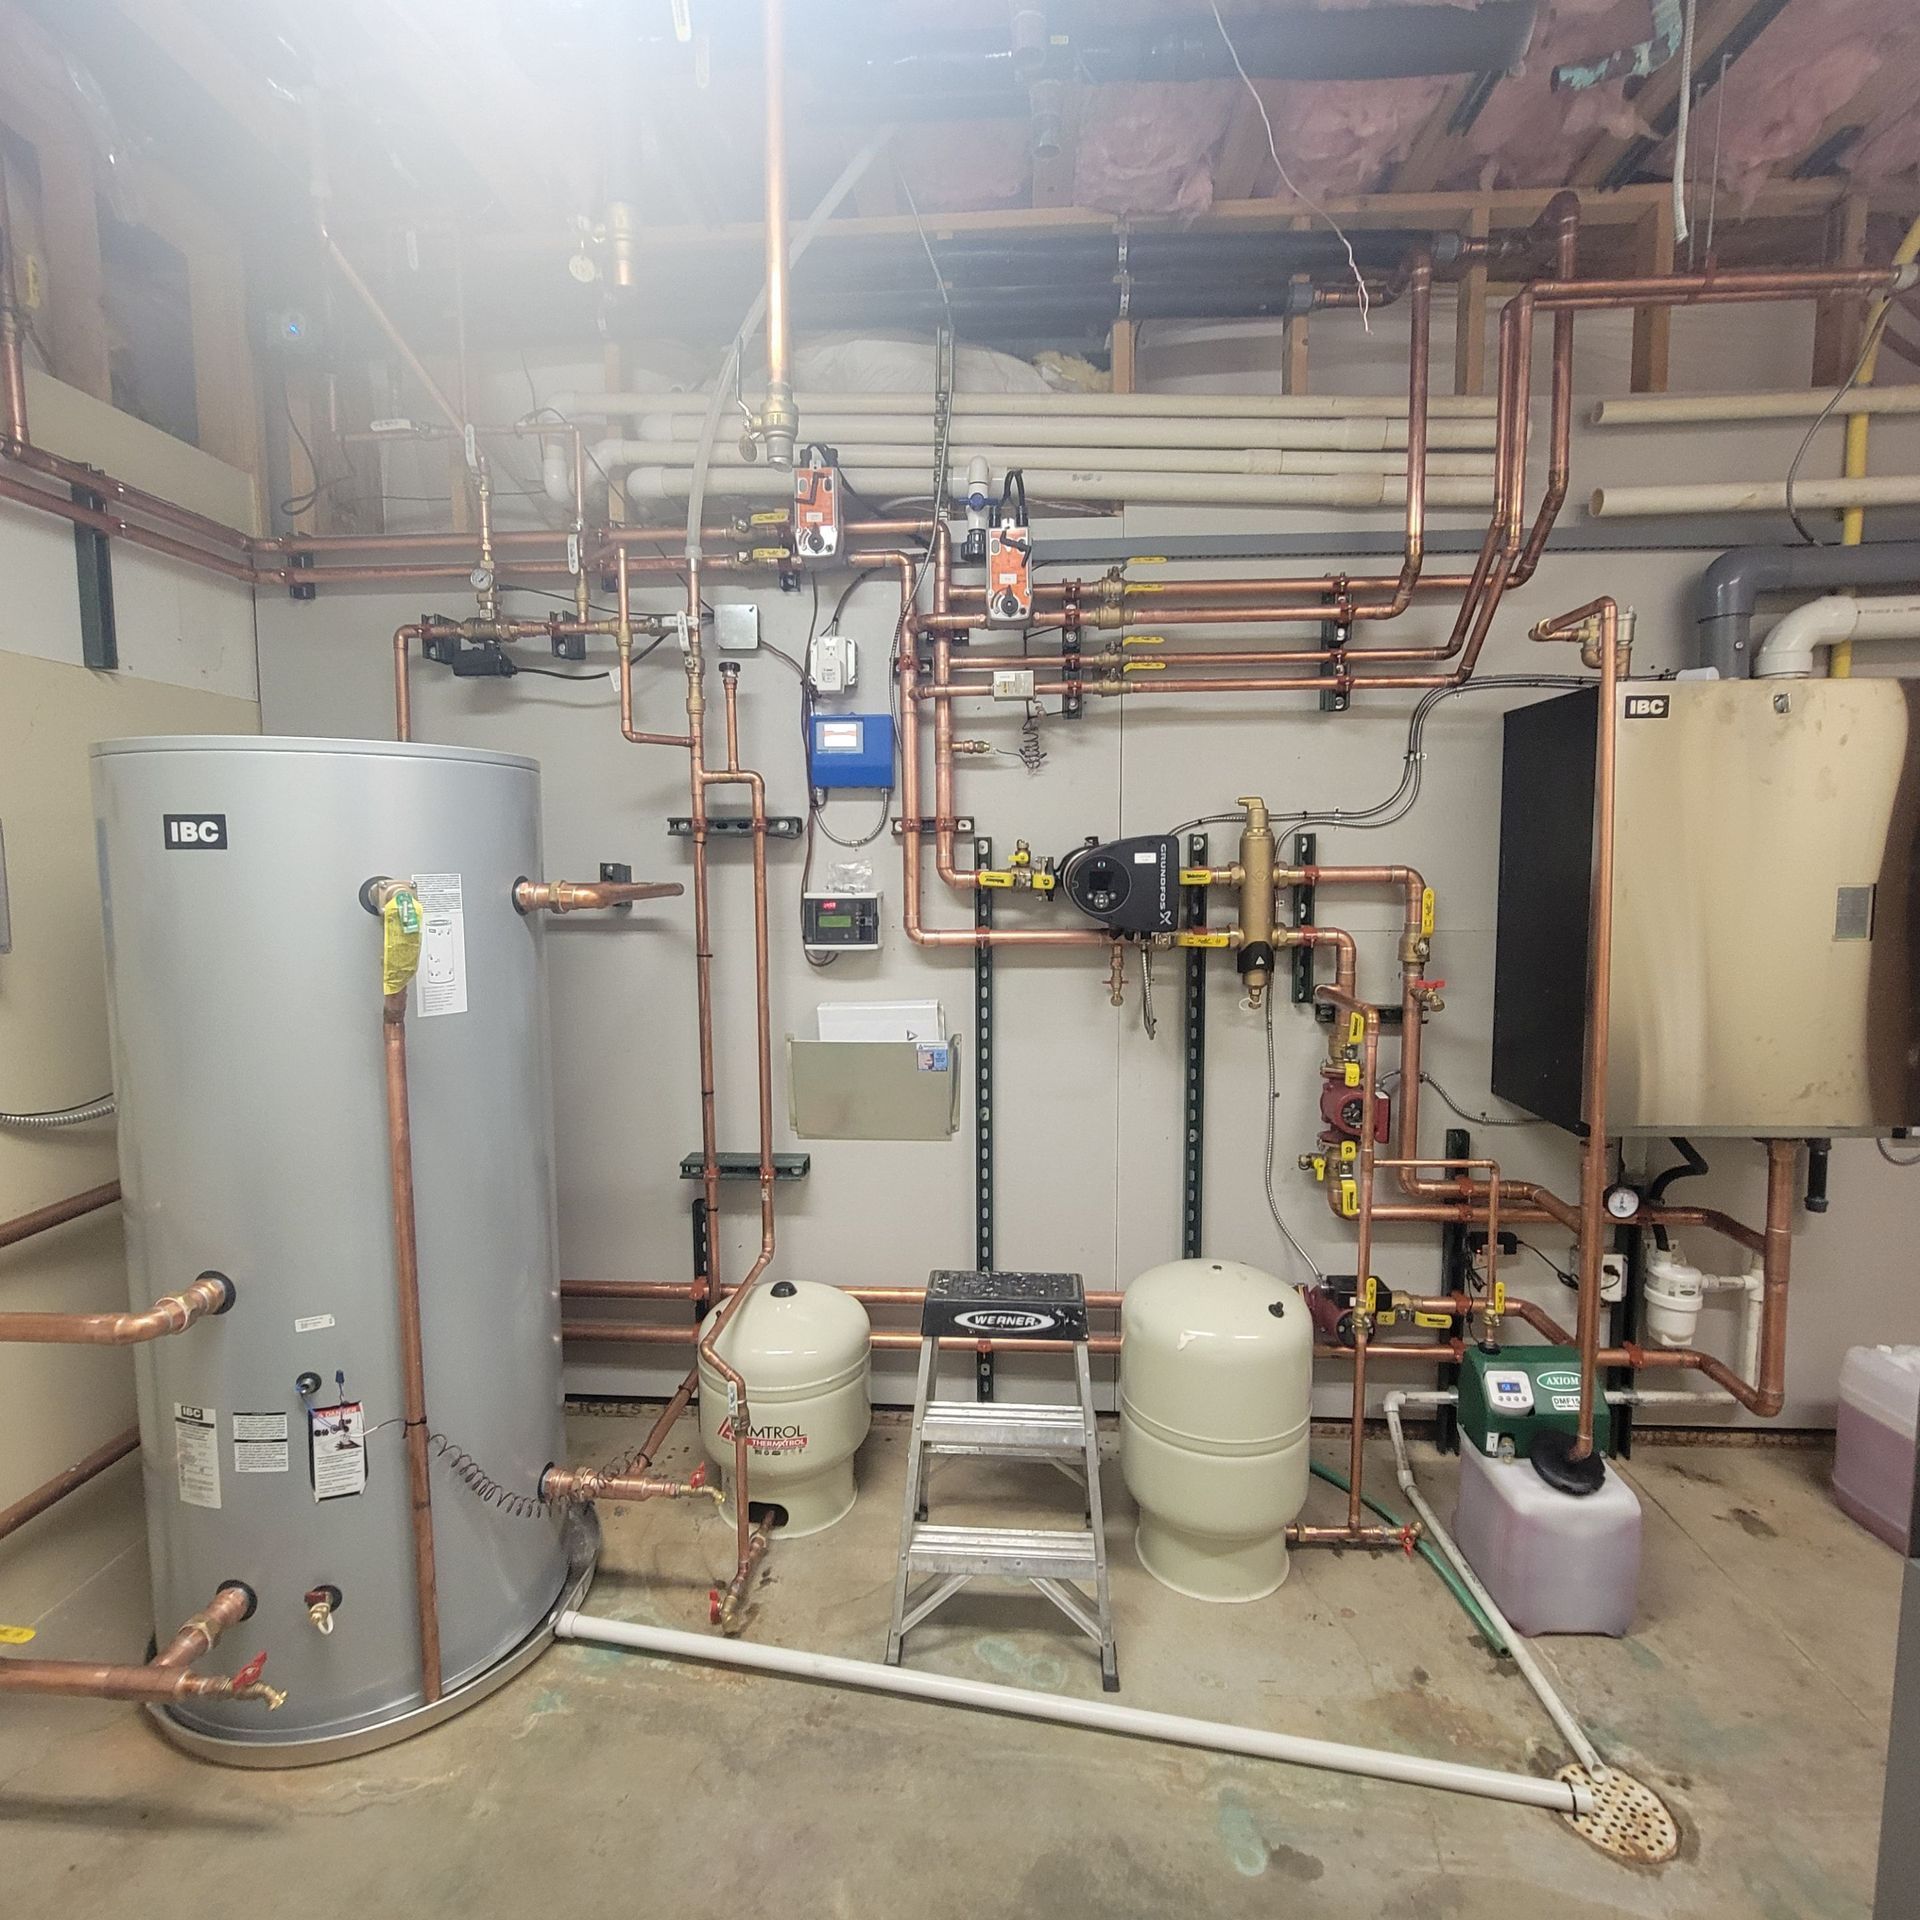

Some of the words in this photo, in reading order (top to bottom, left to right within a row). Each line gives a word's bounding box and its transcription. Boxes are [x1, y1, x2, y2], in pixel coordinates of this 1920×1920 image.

[1629, 699, 1665, 715] IBC
[170, 821, 220, 843] IBC
[1159, 843, 1168, 911] GRUNDFOS
[974, 1315, 1037, 1326] WERNER
[1546, 1377, 1580, 1386] AXIOM
[182, 1406, 202, 1419] IBC
[747, 1425, 808, 1439] MTROL
